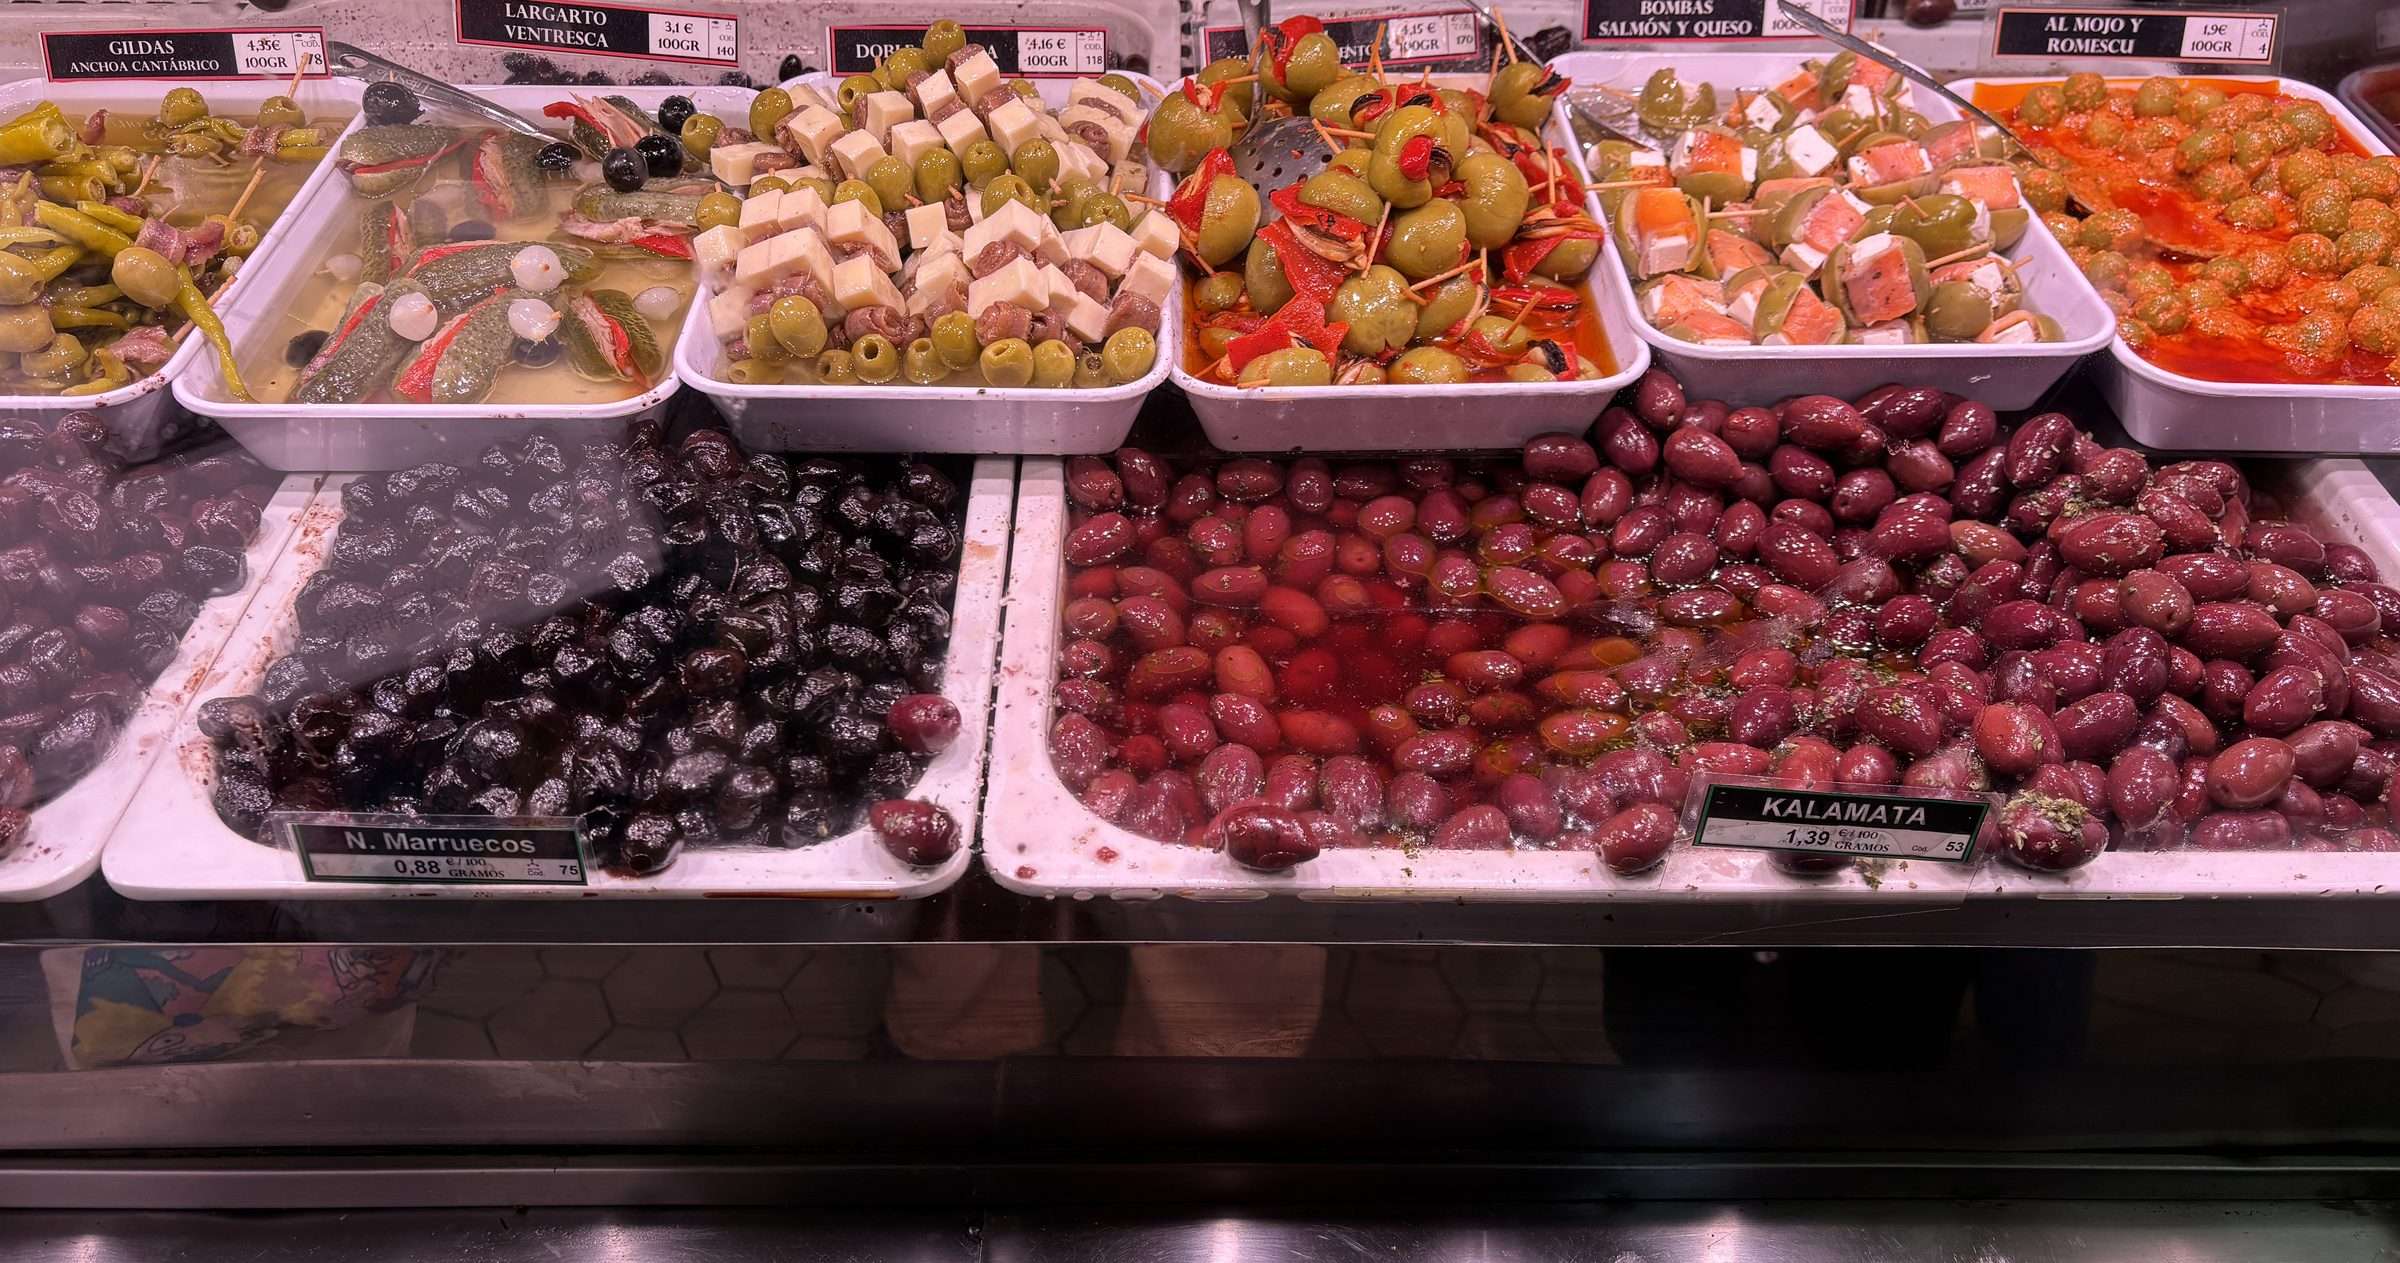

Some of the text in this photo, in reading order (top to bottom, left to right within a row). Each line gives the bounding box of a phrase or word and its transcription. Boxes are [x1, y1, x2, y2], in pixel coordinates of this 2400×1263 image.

[504, 3, 608, 26] LARGARTO
[1640, 0, 1714, 16] BOMBAS
[664, 21, 694, 35] 3,1 €
[1427, 22, 1437, 34] €
[1598, 18, 1752, 37] SALMÓN Y QUESO
[2044, 17, 2144, 34] AL MOJO Y
[504, 24, 609, 48] VENTRESCA
[1456, 34, 1474, 45] 170
[109, 40, 175, 55] GILDAS
[658, 37, 702, 53] 100GR
[717, 46, 735, 56] 140
[1056, 38, 1066, 50] €
[2046, 38, 2136, 54] ROMESCU
[2191, 40, 2233, 53] 100GR
[2258, 43, 2267, 54] 4
[70, 57, 220, 73] ANCHOA CANTÁBRICO
[245, 56, 288, 69] 100GR
[1027, 55, 1069, 66] 100GR
[1086, 55, 1103, 65] 118
[1761, 796, 1927, 826] KALAMATA
[344, 831, 536, 854] N. Marruecos
[1786, 829, 1830, 846] 1,39
[1834, 841, 1890, 853] GRAMOS
[1945, 841, 1965, 852] 53
[394, 859, 441, 876] 0,88
[448, 868, 505, 878] GRAMOS
[559, 864, 579, 876] 75
